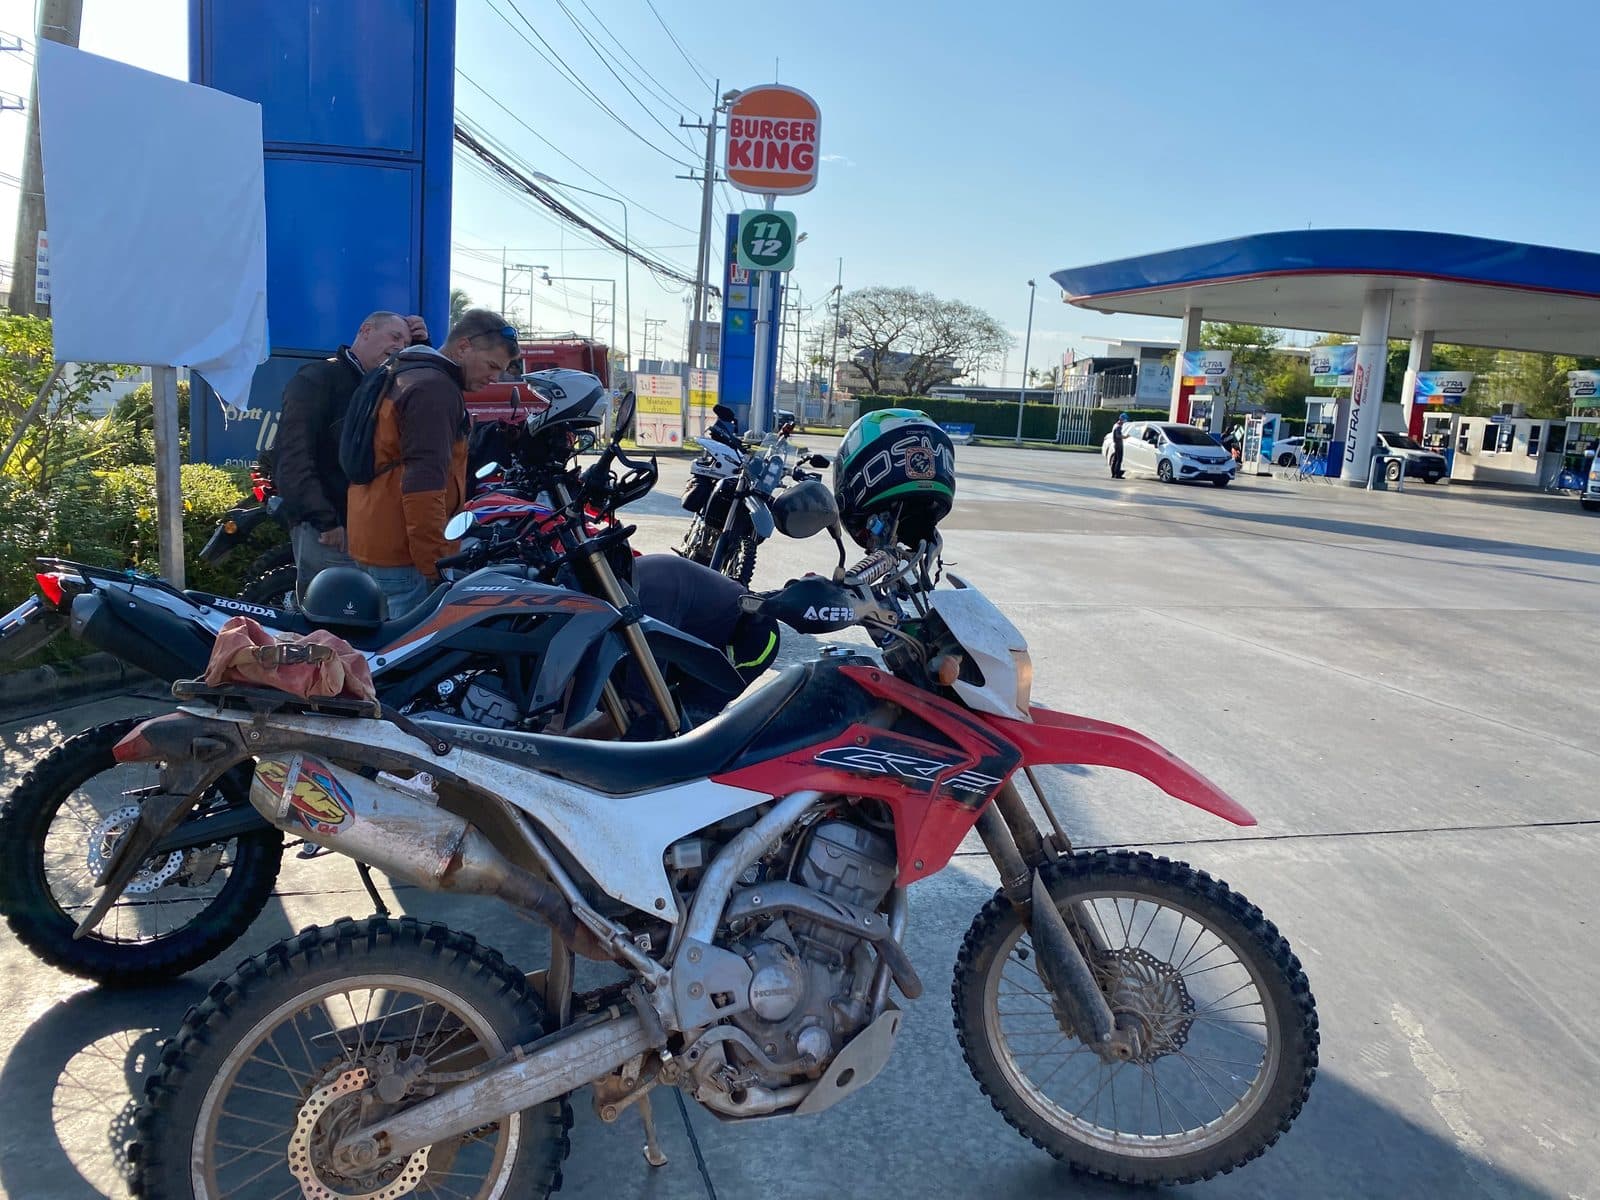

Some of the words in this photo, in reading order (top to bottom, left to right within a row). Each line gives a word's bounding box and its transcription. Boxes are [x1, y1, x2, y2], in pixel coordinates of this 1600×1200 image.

[730, 118, 815, 142] BURGER
[729, 139, 814, 171] KING
[754, 221, 781, 239] 11
[751, 239, 782, 257] 12
[1345, 407, 1360, 463] ULTRA
[213, 598, 277, 618] HONDA
[454, 728, 540, 756] HONDA
